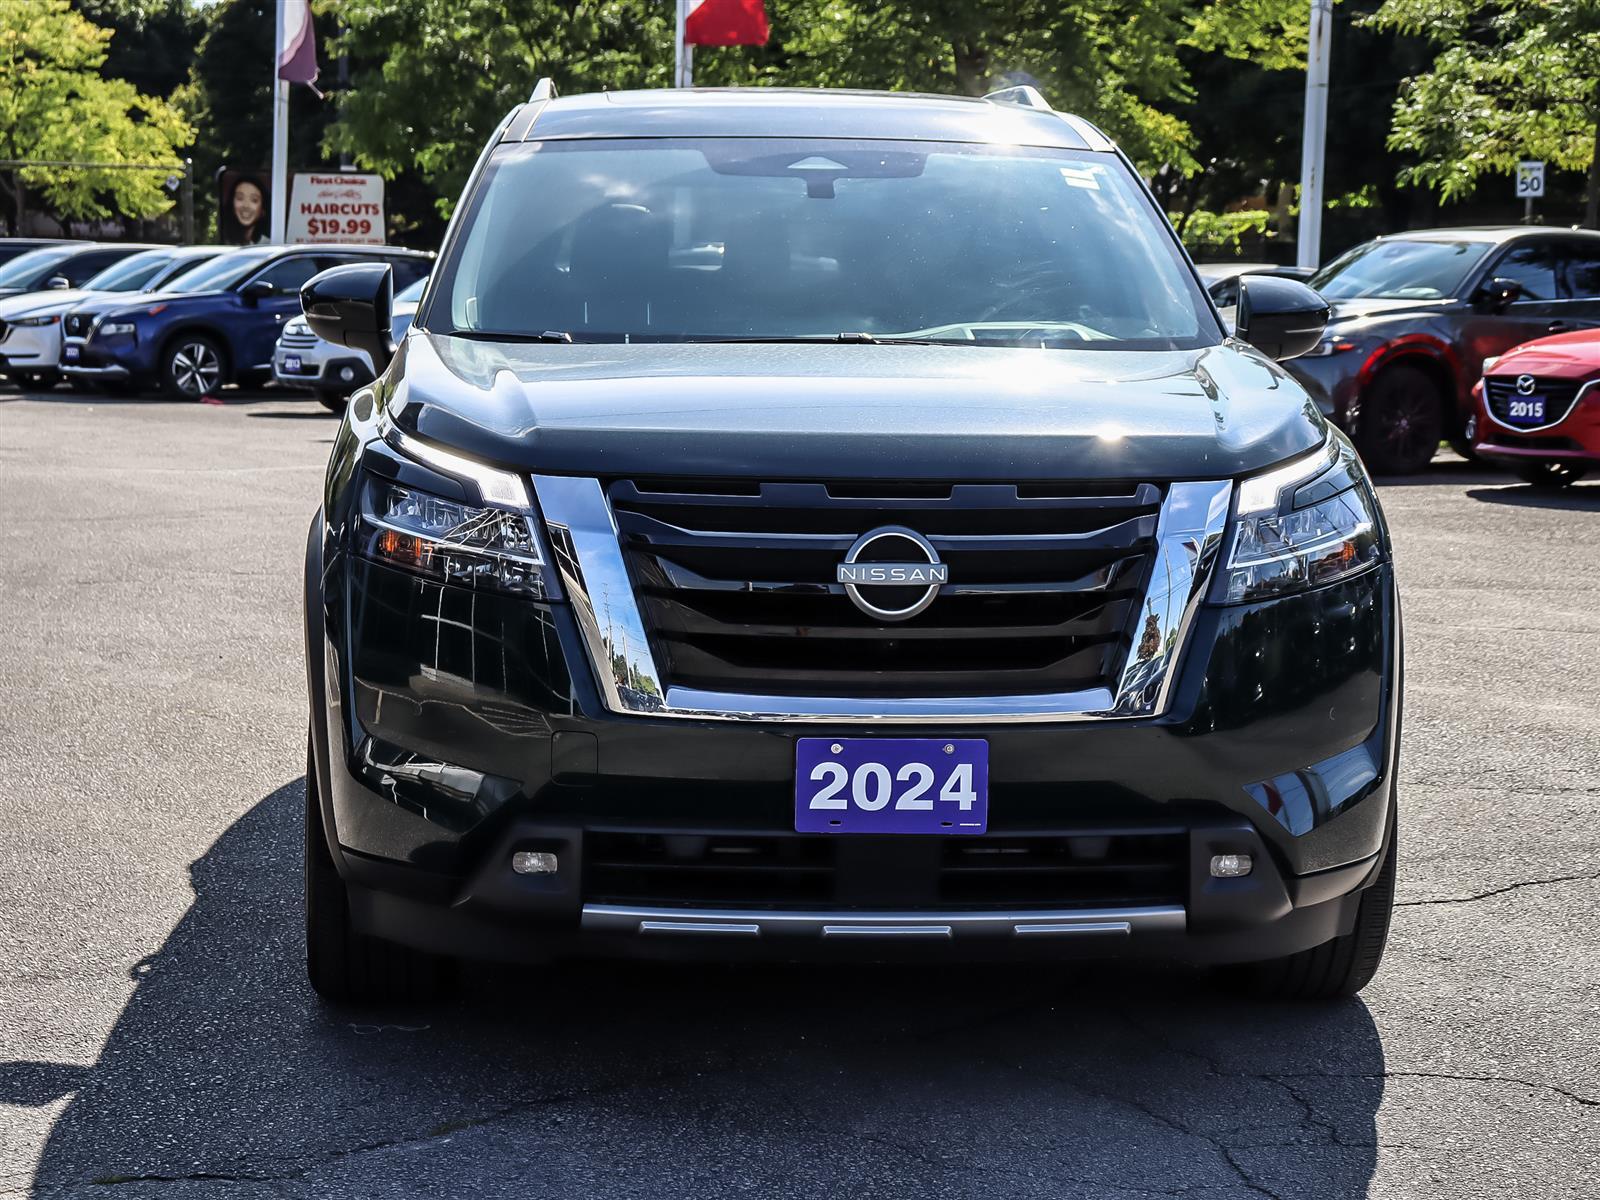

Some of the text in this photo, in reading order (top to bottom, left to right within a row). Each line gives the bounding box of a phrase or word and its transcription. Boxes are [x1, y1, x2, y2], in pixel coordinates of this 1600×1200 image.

[310, 176, 333, 185] First
[1520, 176, 1541, 192] 50
[300, 203, 380, 216] HAIRCUTS
[307, 216, 372, 236] $19.99
[1510, 401, 1544, 418] 2015
[840, 567, 946, 582] NISSAN
[808, 761, 978, 812] 2024
